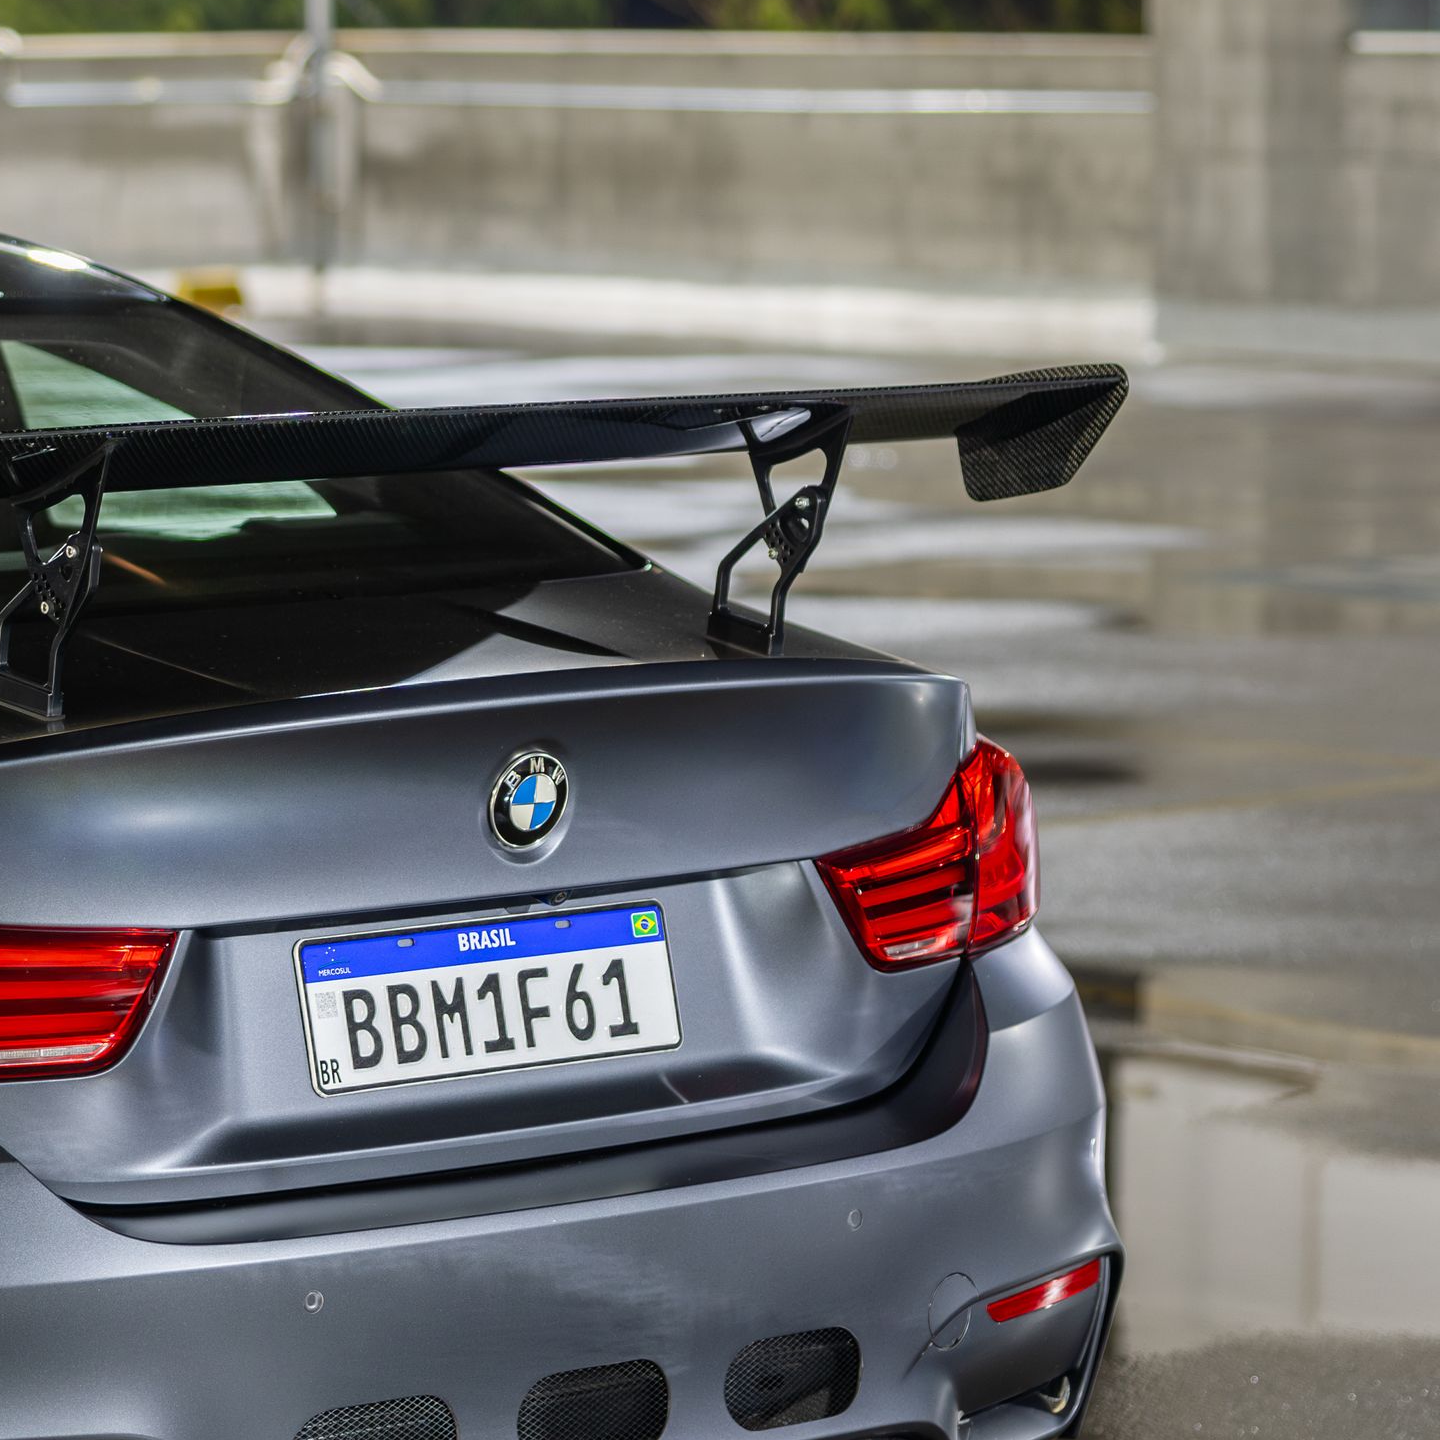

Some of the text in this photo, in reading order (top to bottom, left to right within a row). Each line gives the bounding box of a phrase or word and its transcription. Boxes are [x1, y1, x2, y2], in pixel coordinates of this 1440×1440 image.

[506, 756, 565, 792] BMW
[457, 928, 516, 952] BRASIL
[318, 967, 352, 977] MERCOSUL
[341, 958, 641, 1070] BBM1F61
[319, 1058, 342, 1086] BR
